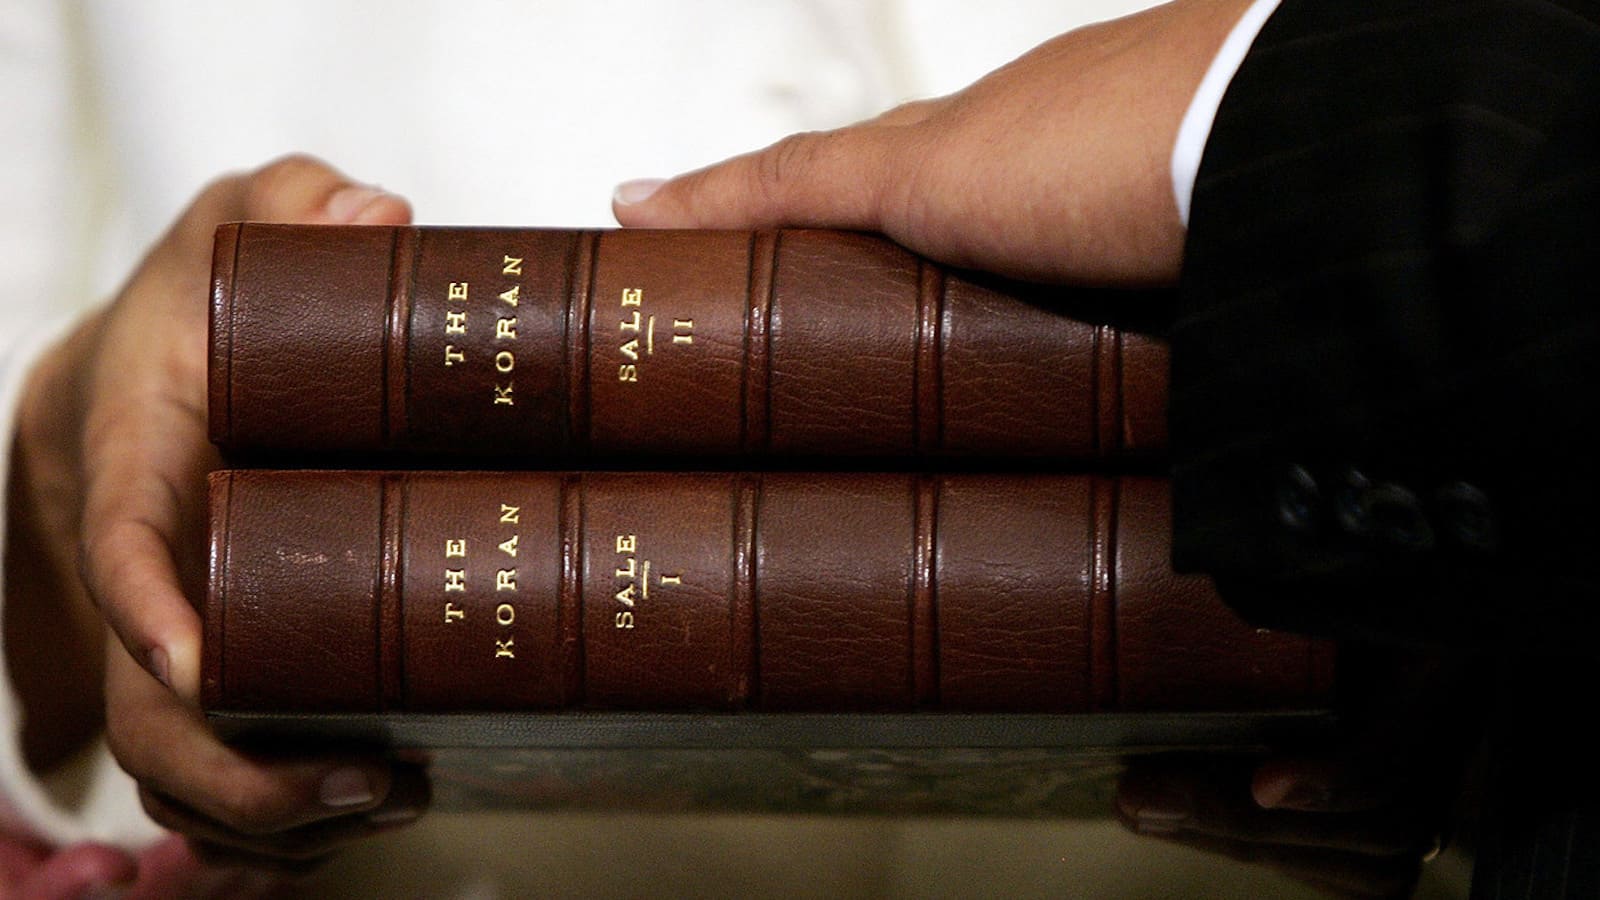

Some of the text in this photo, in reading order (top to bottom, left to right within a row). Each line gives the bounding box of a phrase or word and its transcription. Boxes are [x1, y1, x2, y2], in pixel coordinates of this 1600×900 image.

[445, 282, 469, 366] THE
[494, 254, 523, 406] KORAN
[618, 287, 643, 382] SALE
[672, 318, 694, 345] II
[445, 538, 466, 623] THE
[495, 503, 520, 659] KORAN
[615, 534, 637, 629] SALE
[661, 574, 682, 586] I
